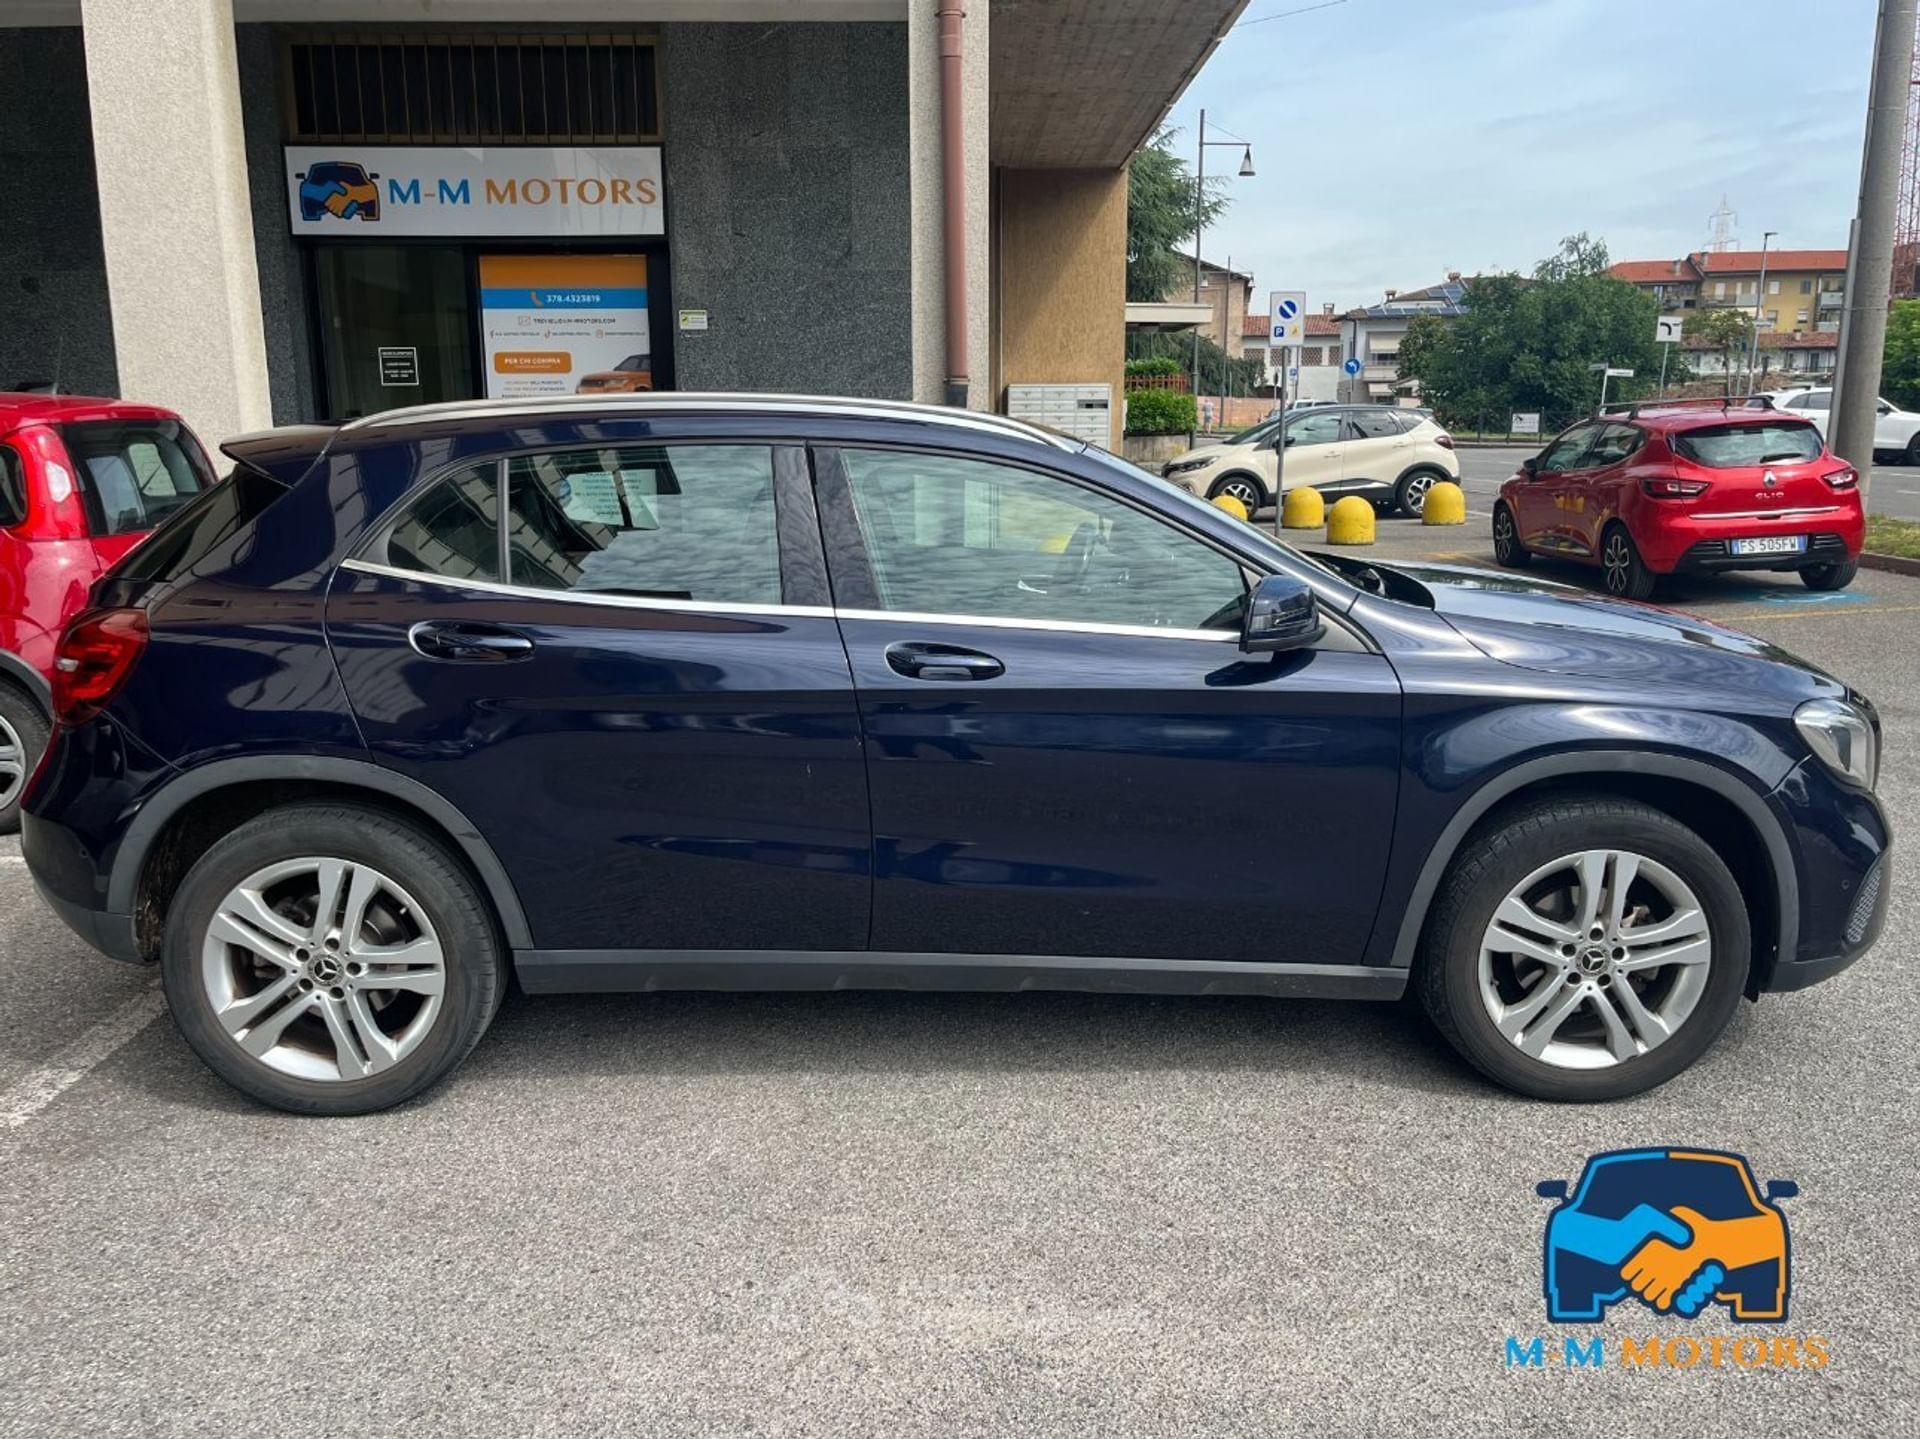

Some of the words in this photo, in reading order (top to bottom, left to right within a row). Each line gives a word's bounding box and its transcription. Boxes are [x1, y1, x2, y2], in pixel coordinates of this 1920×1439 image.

[389, 178, 471, 205] M-M
[485, 177, 657, 205] MOTORS
[1755, 491, 1784, 499] CLIO
